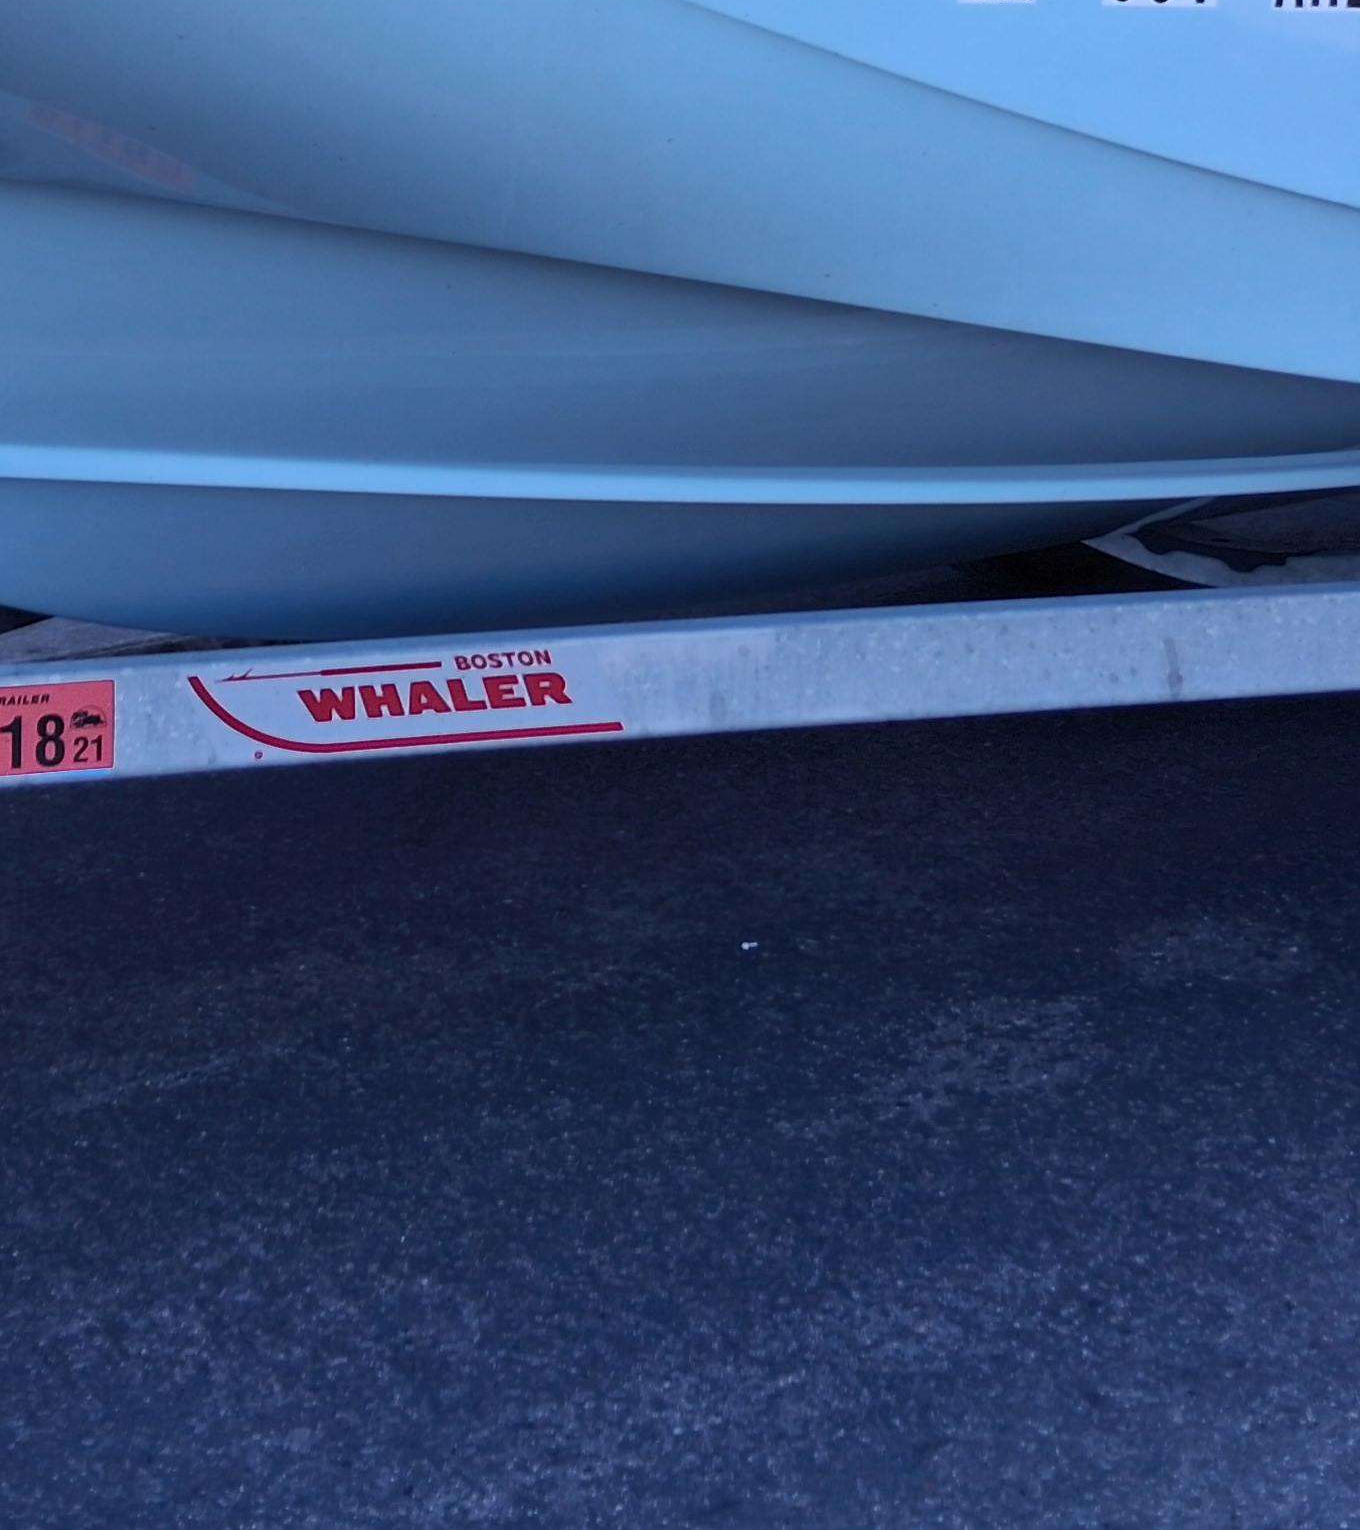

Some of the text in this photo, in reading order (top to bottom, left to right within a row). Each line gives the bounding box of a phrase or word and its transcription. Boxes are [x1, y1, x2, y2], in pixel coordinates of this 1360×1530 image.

[454, 649, 552, 671] BOSTON
[298, 672, 573, 723] WHALER
[72, 734, 103, 763] 21
